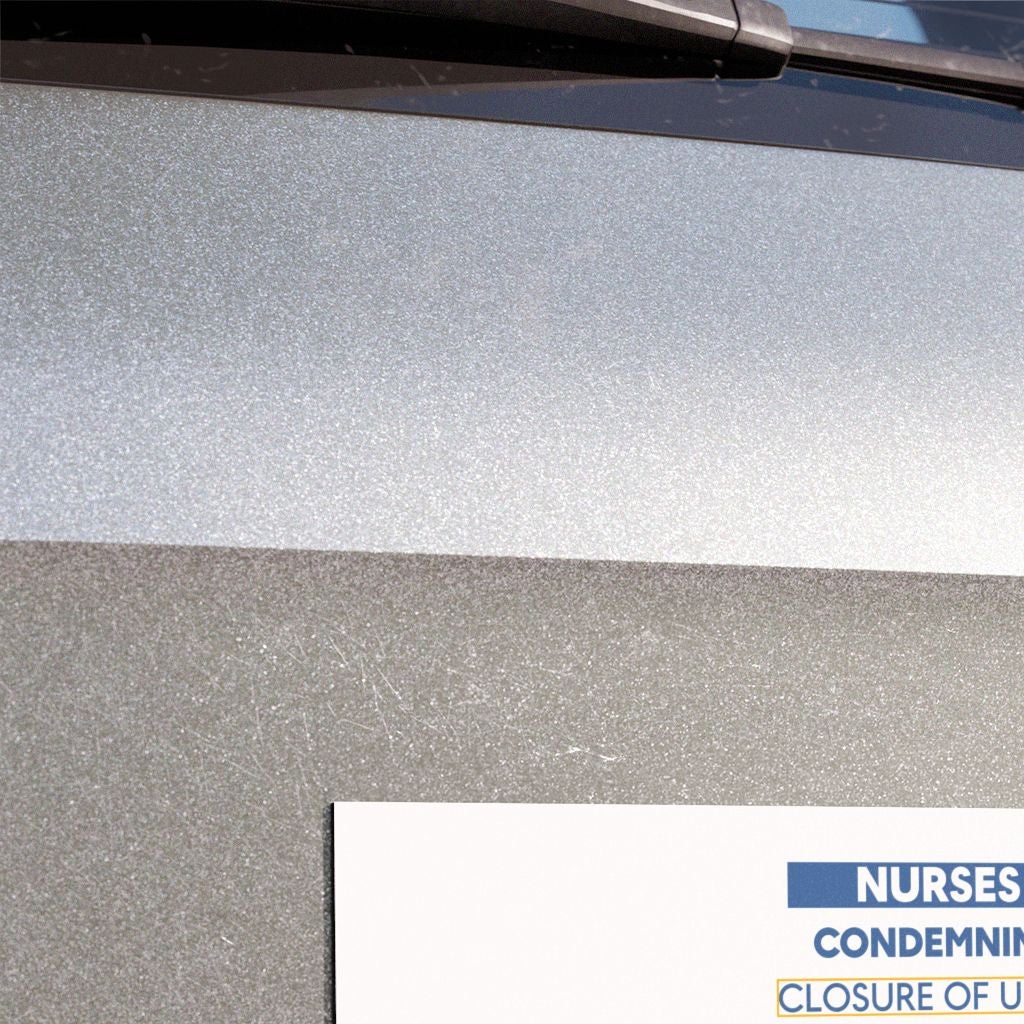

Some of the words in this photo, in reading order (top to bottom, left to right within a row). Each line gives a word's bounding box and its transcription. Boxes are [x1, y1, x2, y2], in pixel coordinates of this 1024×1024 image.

[857, 866, 1021, 903] NURSES
[778, 982, 934, 1013] CLOSURE
[944, 981, 989, 1011] OF
